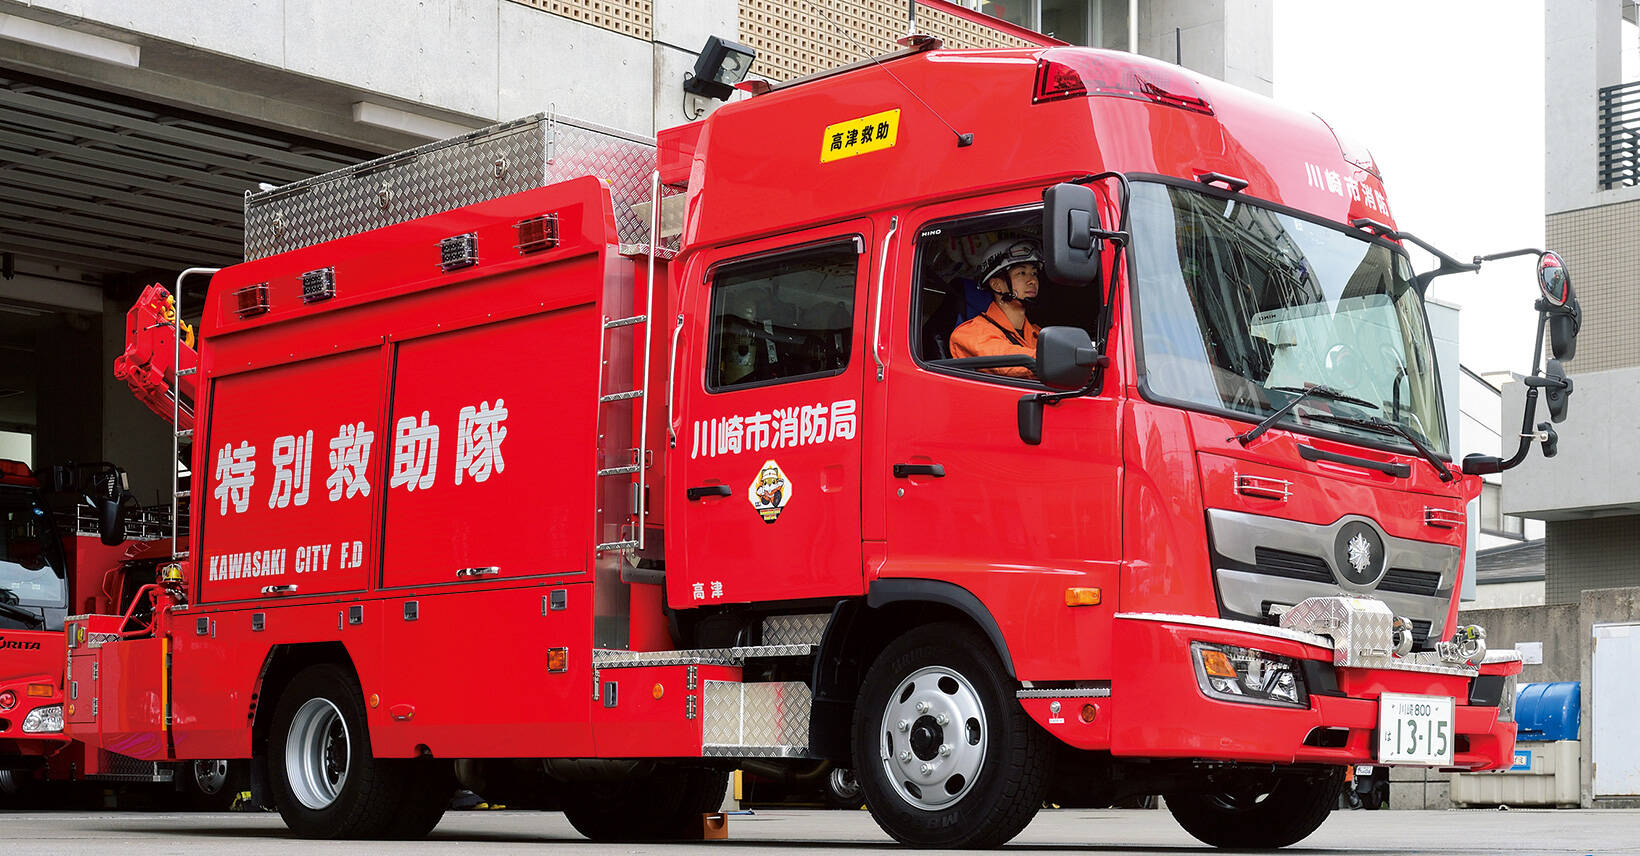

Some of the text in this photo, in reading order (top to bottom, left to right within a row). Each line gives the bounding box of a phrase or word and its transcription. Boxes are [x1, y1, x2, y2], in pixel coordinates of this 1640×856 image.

[831, 121, 889, 151] 高津救助
[921, 229, 942, 237] HINO
[691, 399, 856, 459] 川崎市消防局
[214, 398, 508, 516] 特別救助隊
[209, 541, 363, 581] KAWASAKI CITY F.D
[692, 580, 724, 600] 高津
[1396, 718, 1448, 756] 13-15
